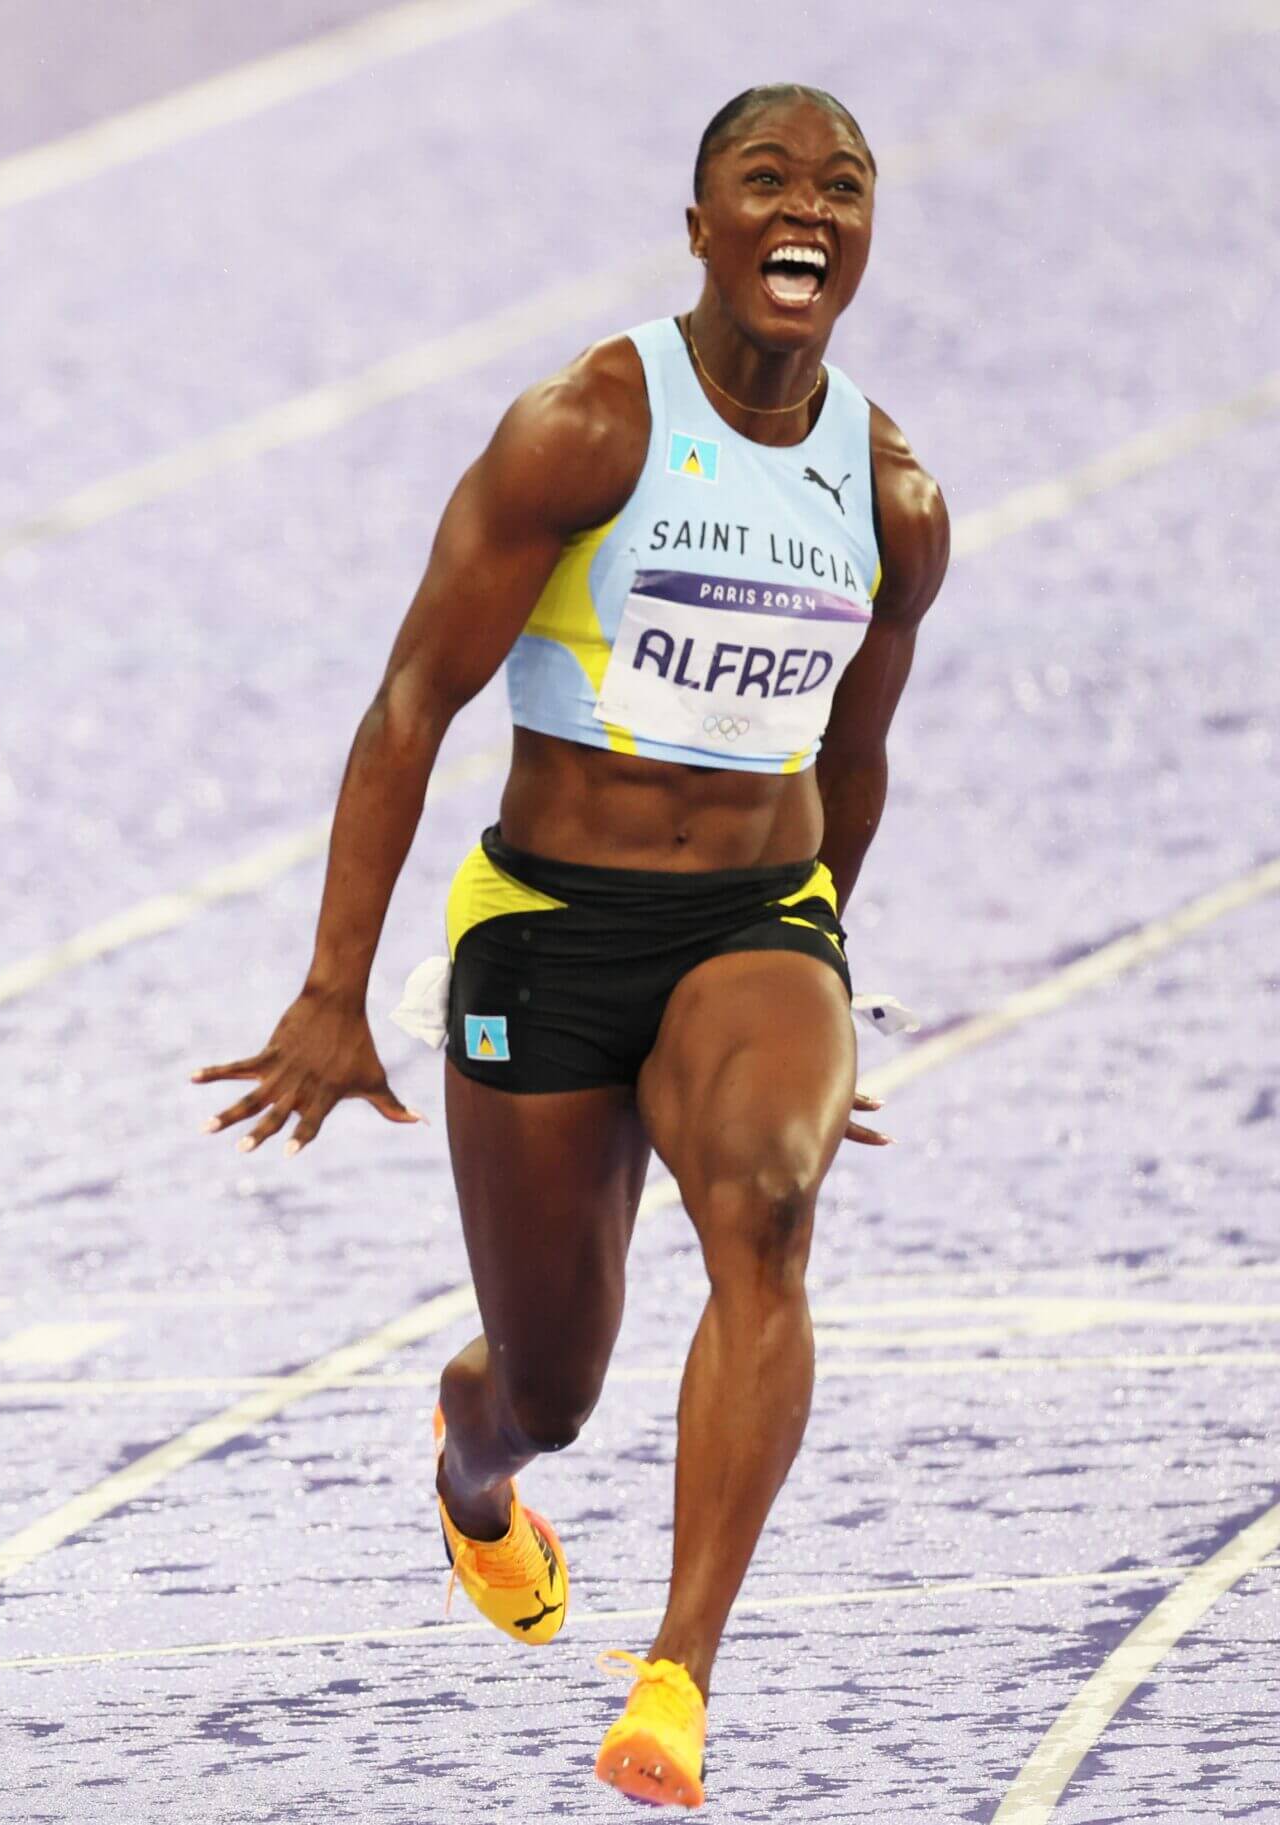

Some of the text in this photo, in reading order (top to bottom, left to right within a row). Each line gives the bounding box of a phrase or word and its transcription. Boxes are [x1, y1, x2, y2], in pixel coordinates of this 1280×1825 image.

[649, 520, 858, 593] SAINT LUCIA
[699, 582, 816, 611] PARIS 2024
[631, 628, 834, 699] ALFRED
